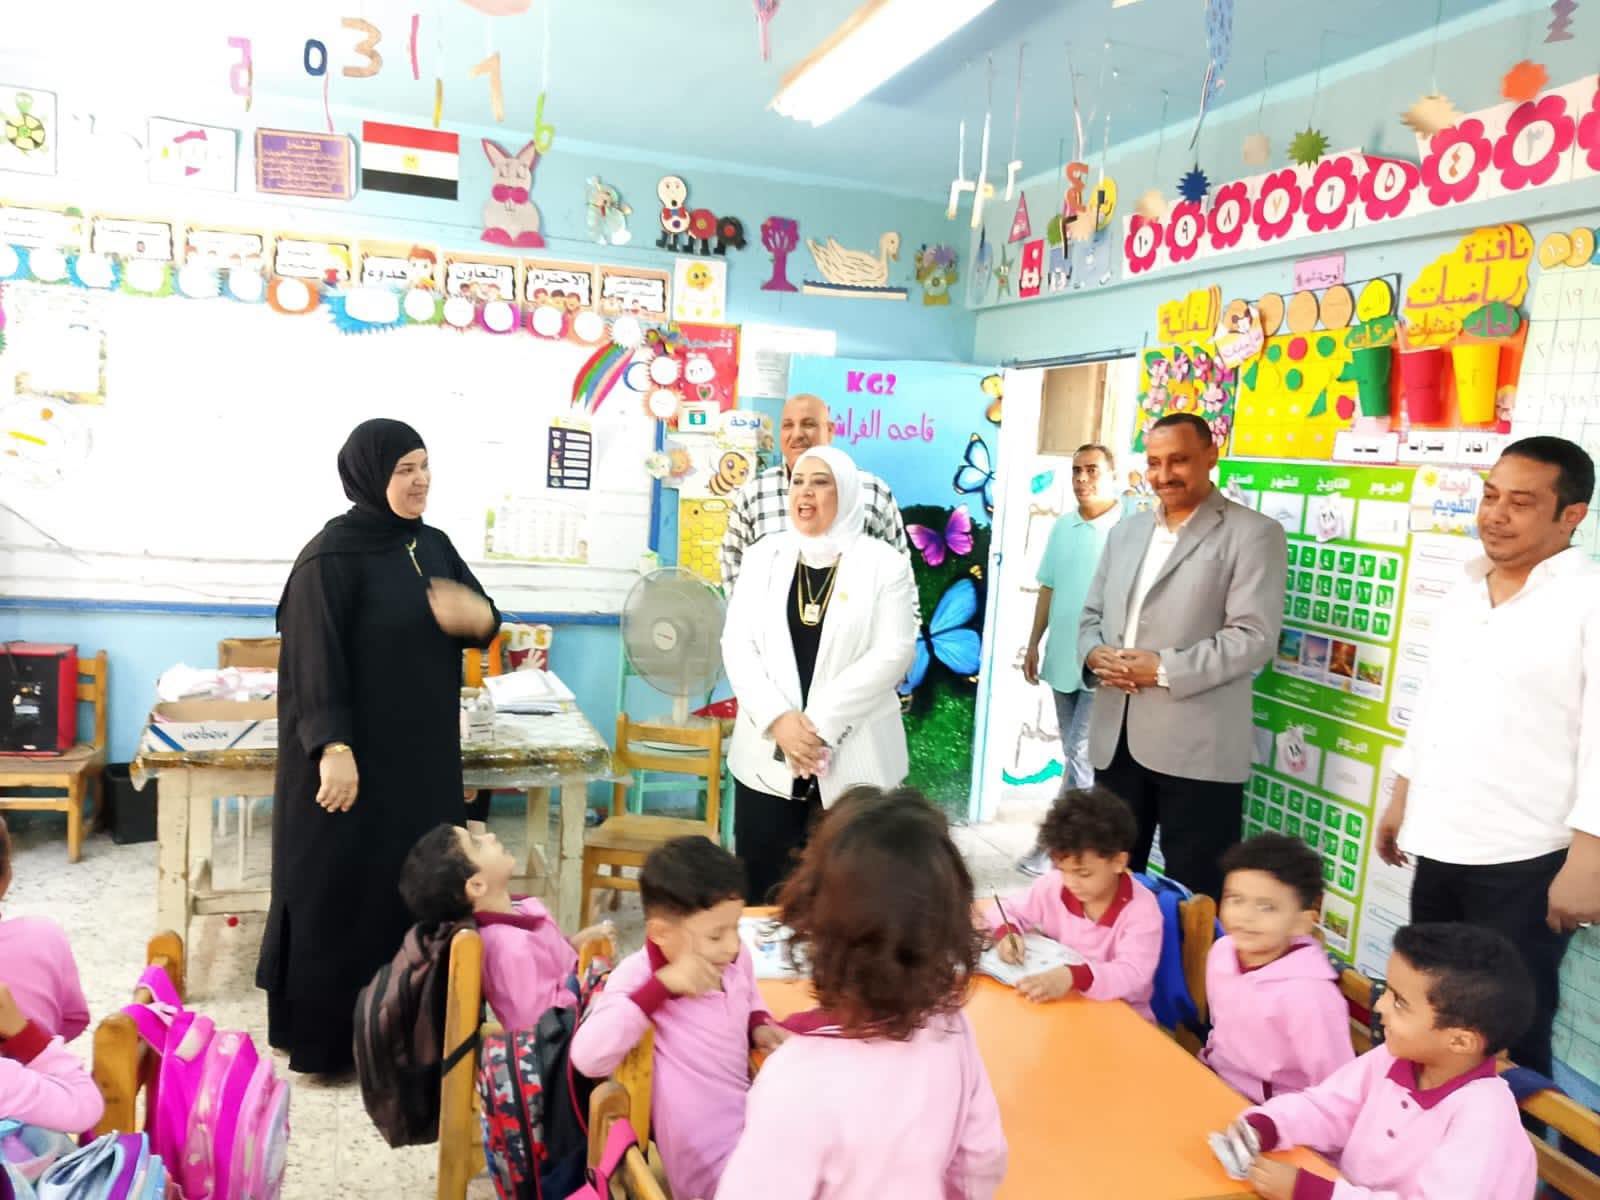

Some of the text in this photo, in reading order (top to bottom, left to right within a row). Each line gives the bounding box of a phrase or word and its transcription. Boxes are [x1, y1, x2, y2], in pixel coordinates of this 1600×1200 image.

[455, 267, 504, 281] التعاون
[532, 273, 587, 287] الاحترام
[846, 369, 897, 395] KG2
